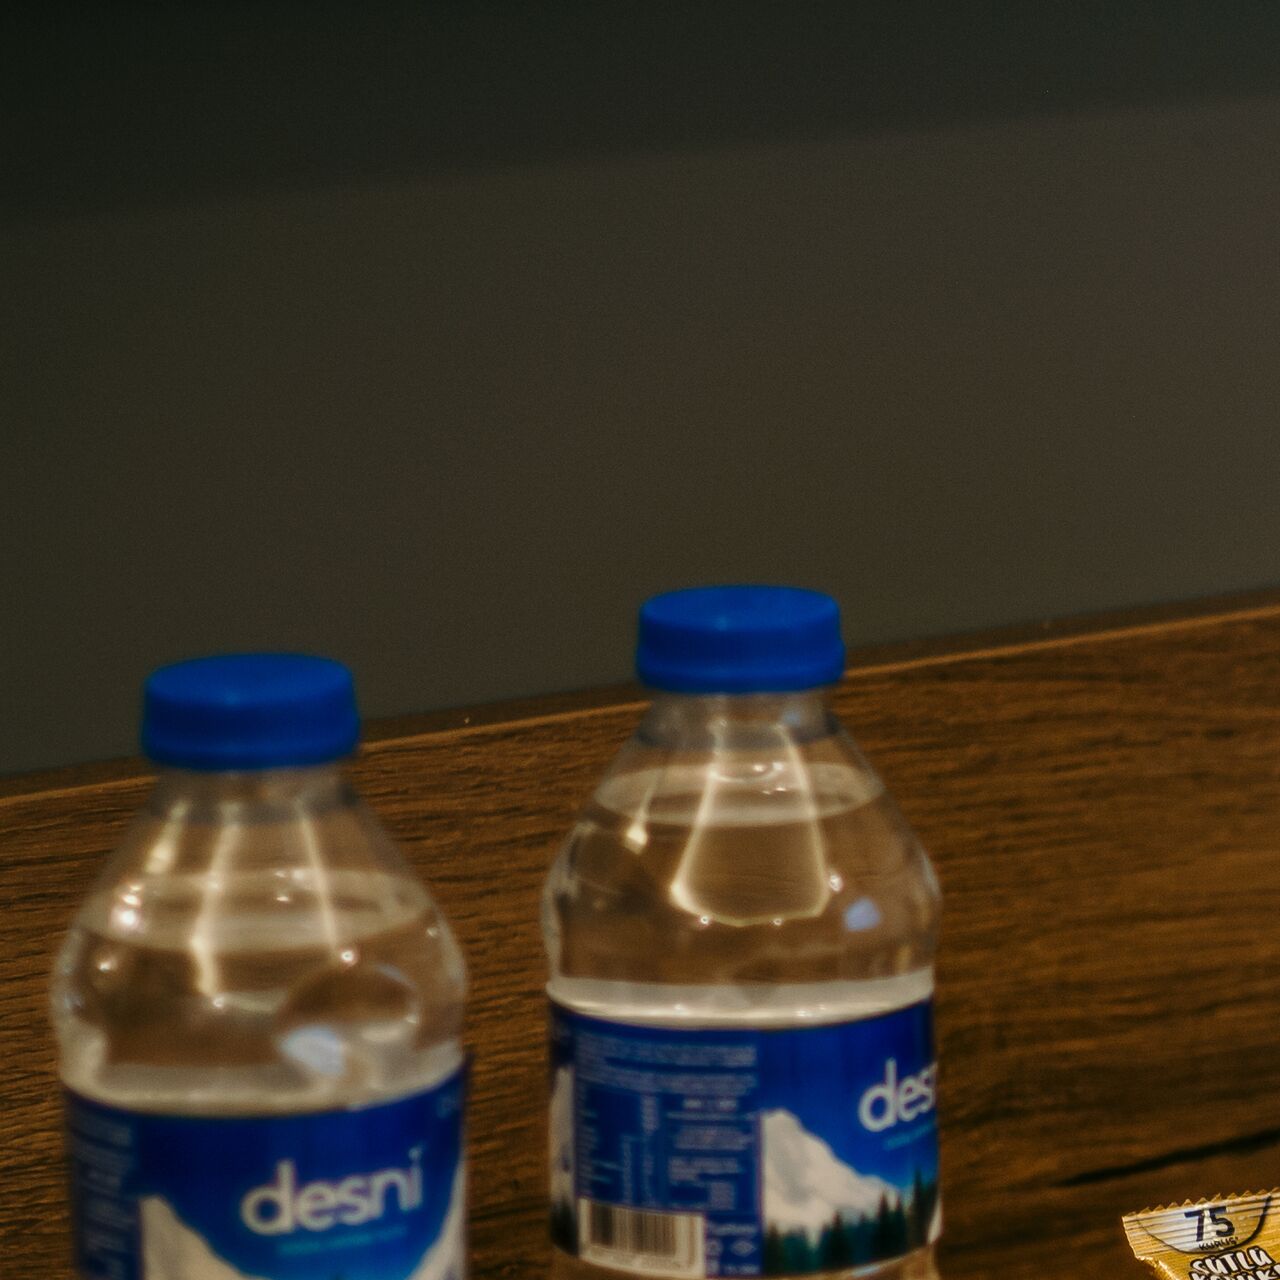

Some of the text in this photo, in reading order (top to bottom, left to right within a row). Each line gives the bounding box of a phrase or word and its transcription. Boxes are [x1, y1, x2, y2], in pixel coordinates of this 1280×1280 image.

[857, 1057, 939, 1133] des
[240, 1146, 424, 1236] desni
[1184, 1206, 1236, 1243] 75
[1190, 1246, 1275, 1275] SÜTLÜ
